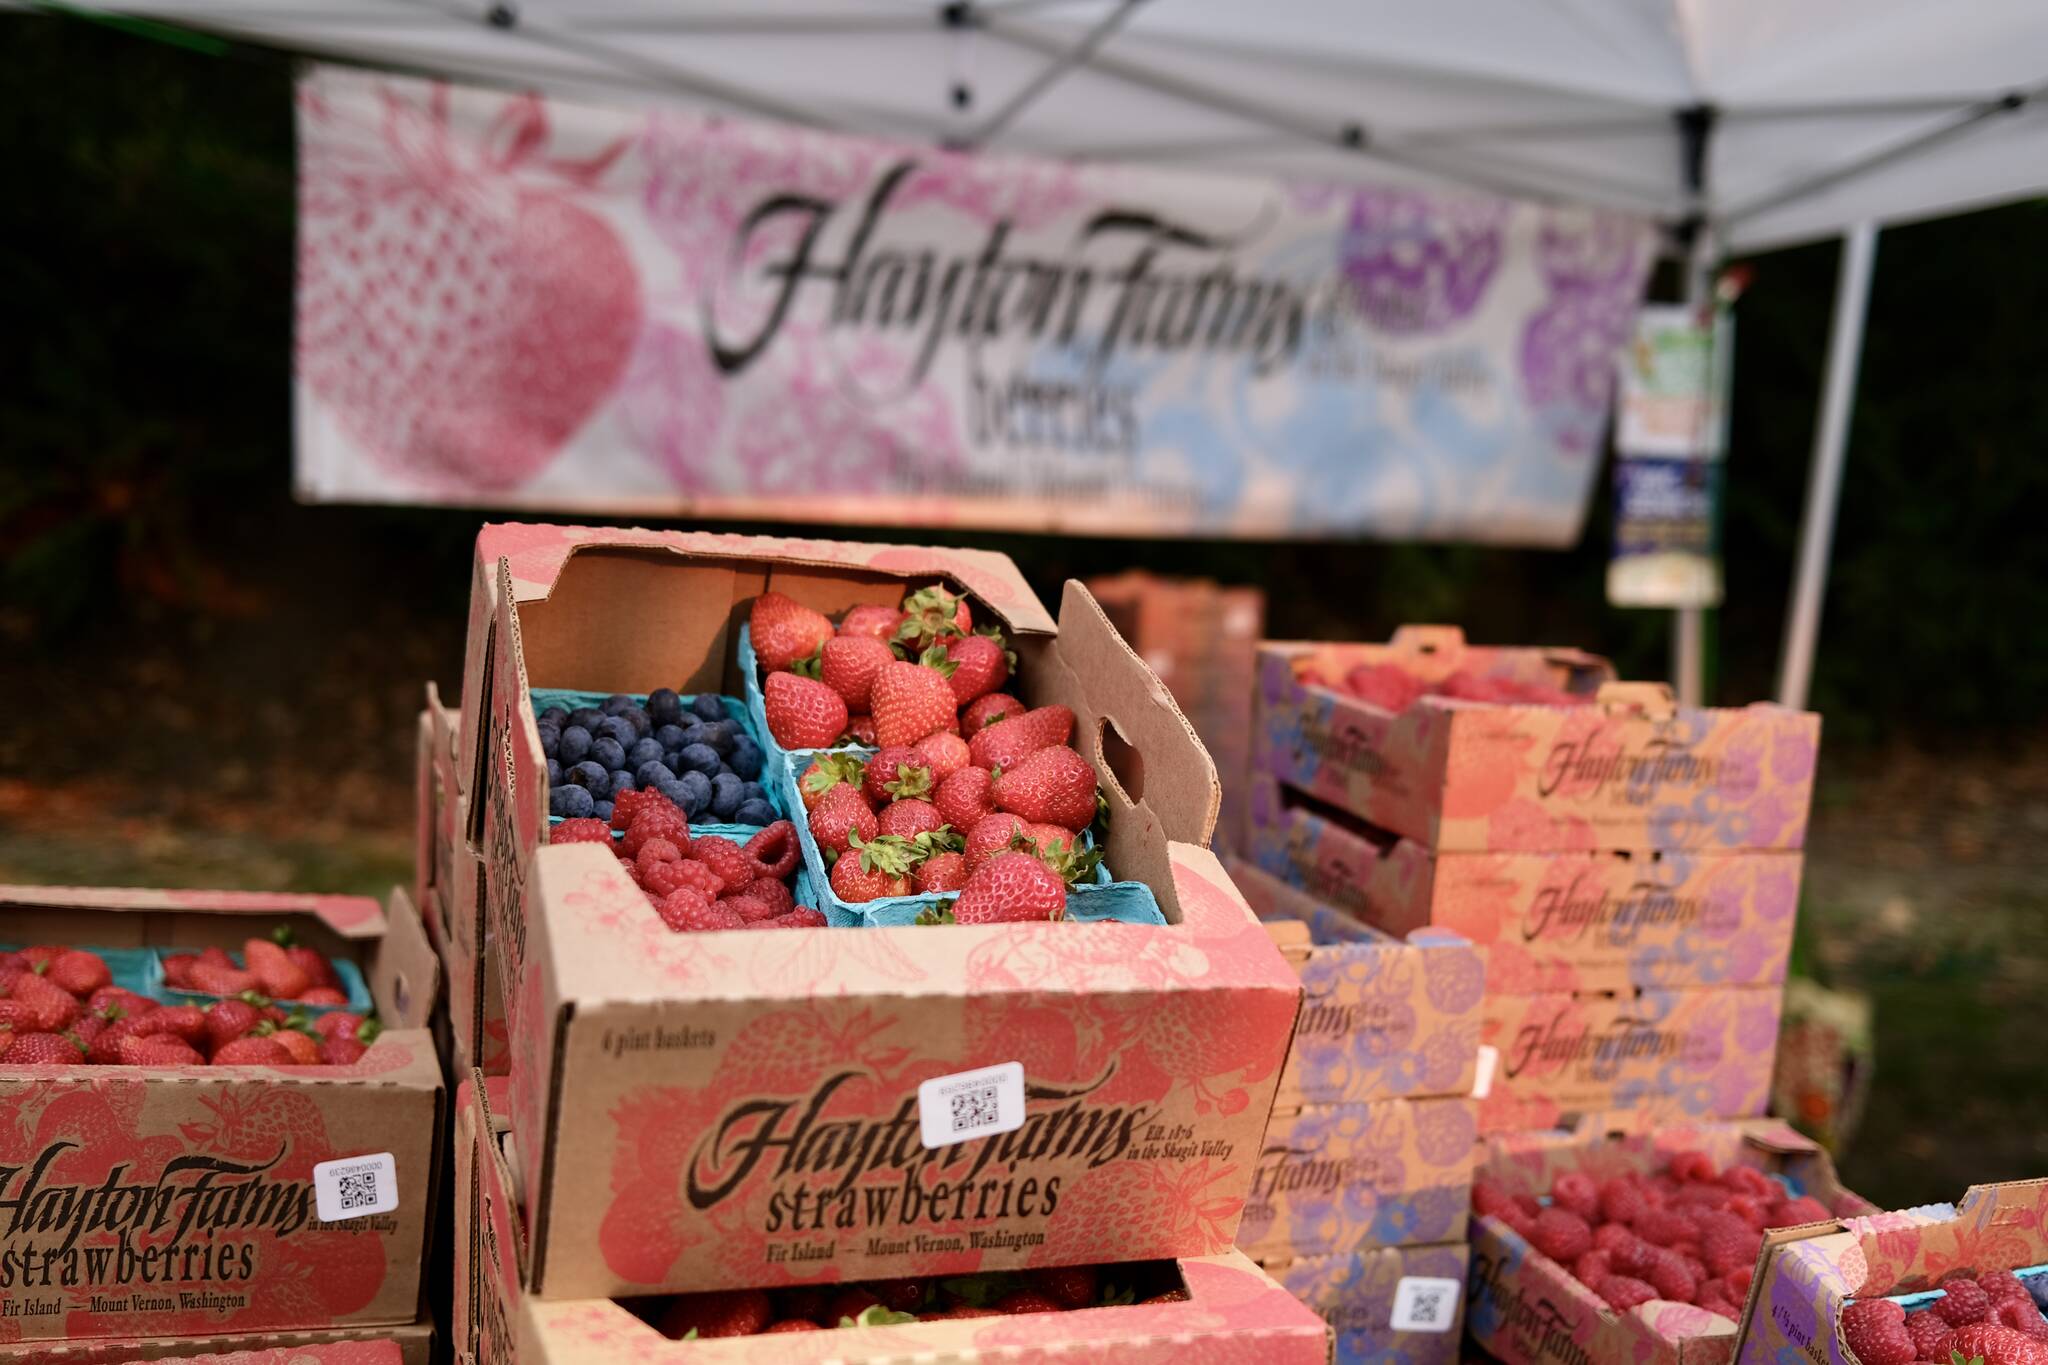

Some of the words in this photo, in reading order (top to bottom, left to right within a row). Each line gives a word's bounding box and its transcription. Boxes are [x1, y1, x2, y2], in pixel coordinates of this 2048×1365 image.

[706, 160, 1092, 388] Hayton
[1070, 196, 1306, 377] Farms
[1126, 1142, 1138, 1160] in
[1140, 1142, 1160, 1159] the
[1161, 1140, 1199, 1163] Skagit
[1200, 1139, 1234, 1162] Valley
[155, 1139, 315, 1258] Farms
[765, 1160, 1062, 1233] strawberries
[307, 1215, 319, 1232] in
[0, 1227, 254, 1288] strawberries
[766, 1243, 786, 1264] Fir
[790, 1239, 835, 1263] Island
[864, 1237, 910, 1259] Mount
[914, 1233, 965, 1255] Vernon,
[968, 1228, 1045, 1253] Washington
[2, 1299, 21, 1318] Fir
[23, 1297, 62, 1316] Island
[89, 1295, 129, 1313] Mount
[132, 1294, 176, 1313] Vernon,
[179, 1291, 246, 1313] Washington
[1788, 1323, 1806, 1346] pint
